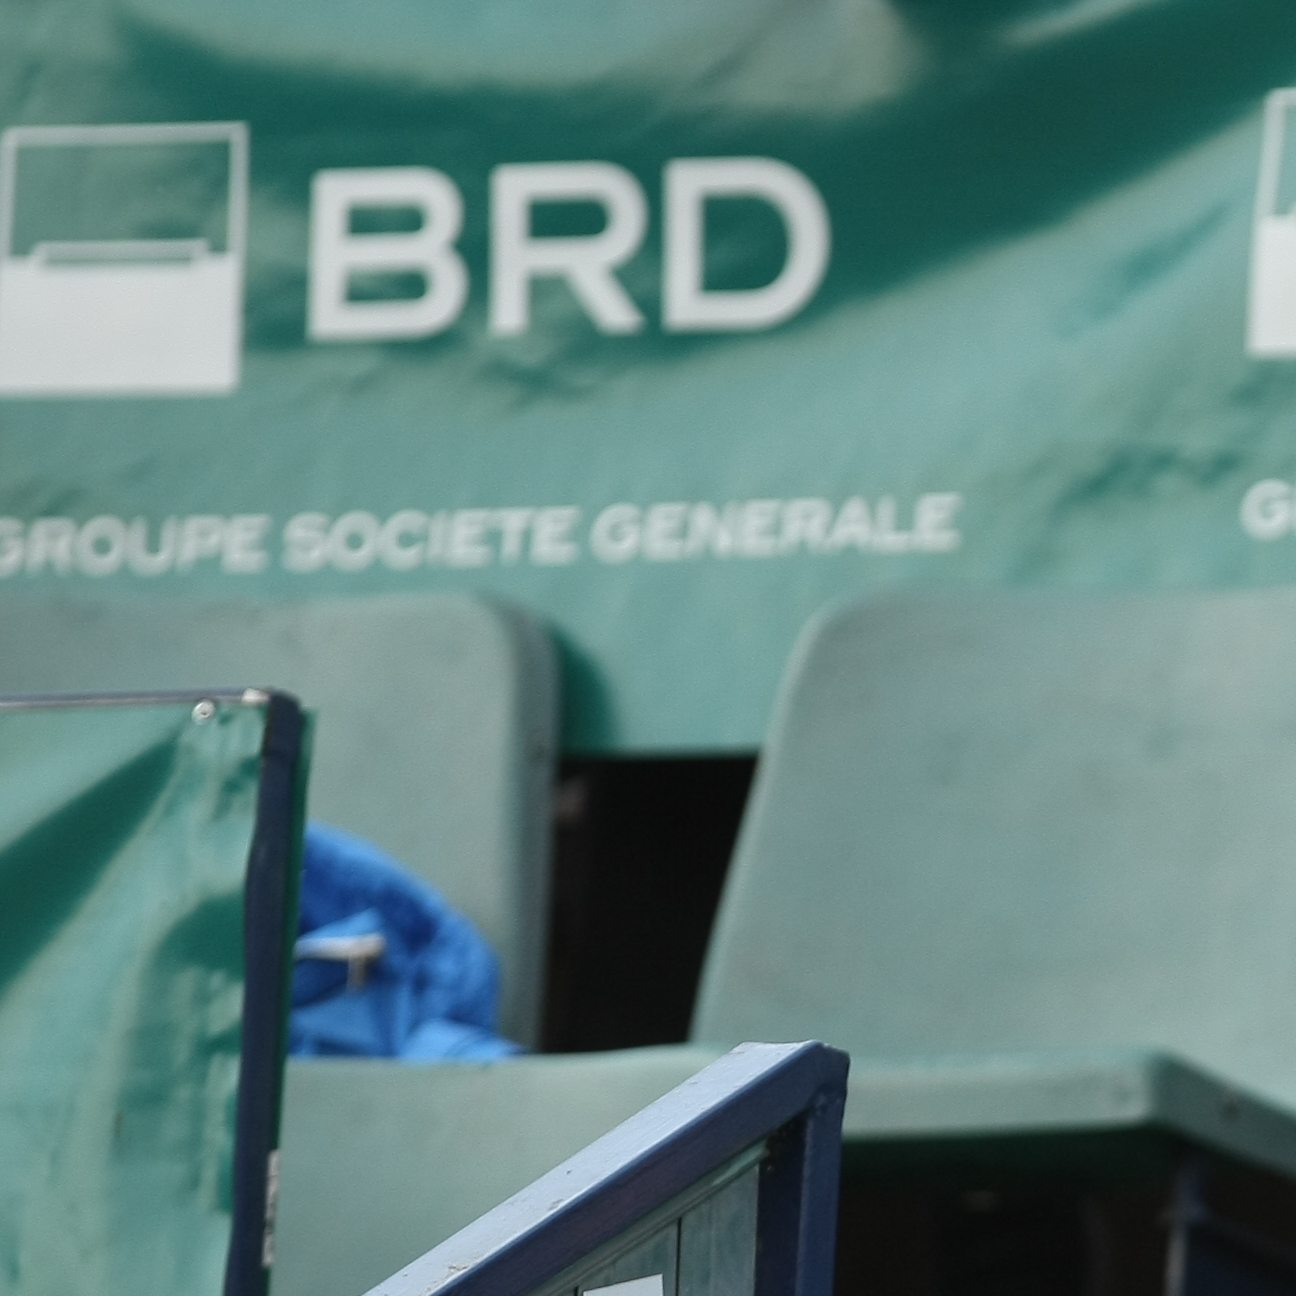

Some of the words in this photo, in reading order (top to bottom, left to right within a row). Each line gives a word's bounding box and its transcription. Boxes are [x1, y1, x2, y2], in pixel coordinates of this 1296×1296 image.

[305, 155, 832, 342] BRD
[281, 504, 580, 575] SOCIETE
[591, 492, 962, 564] GENERALE
